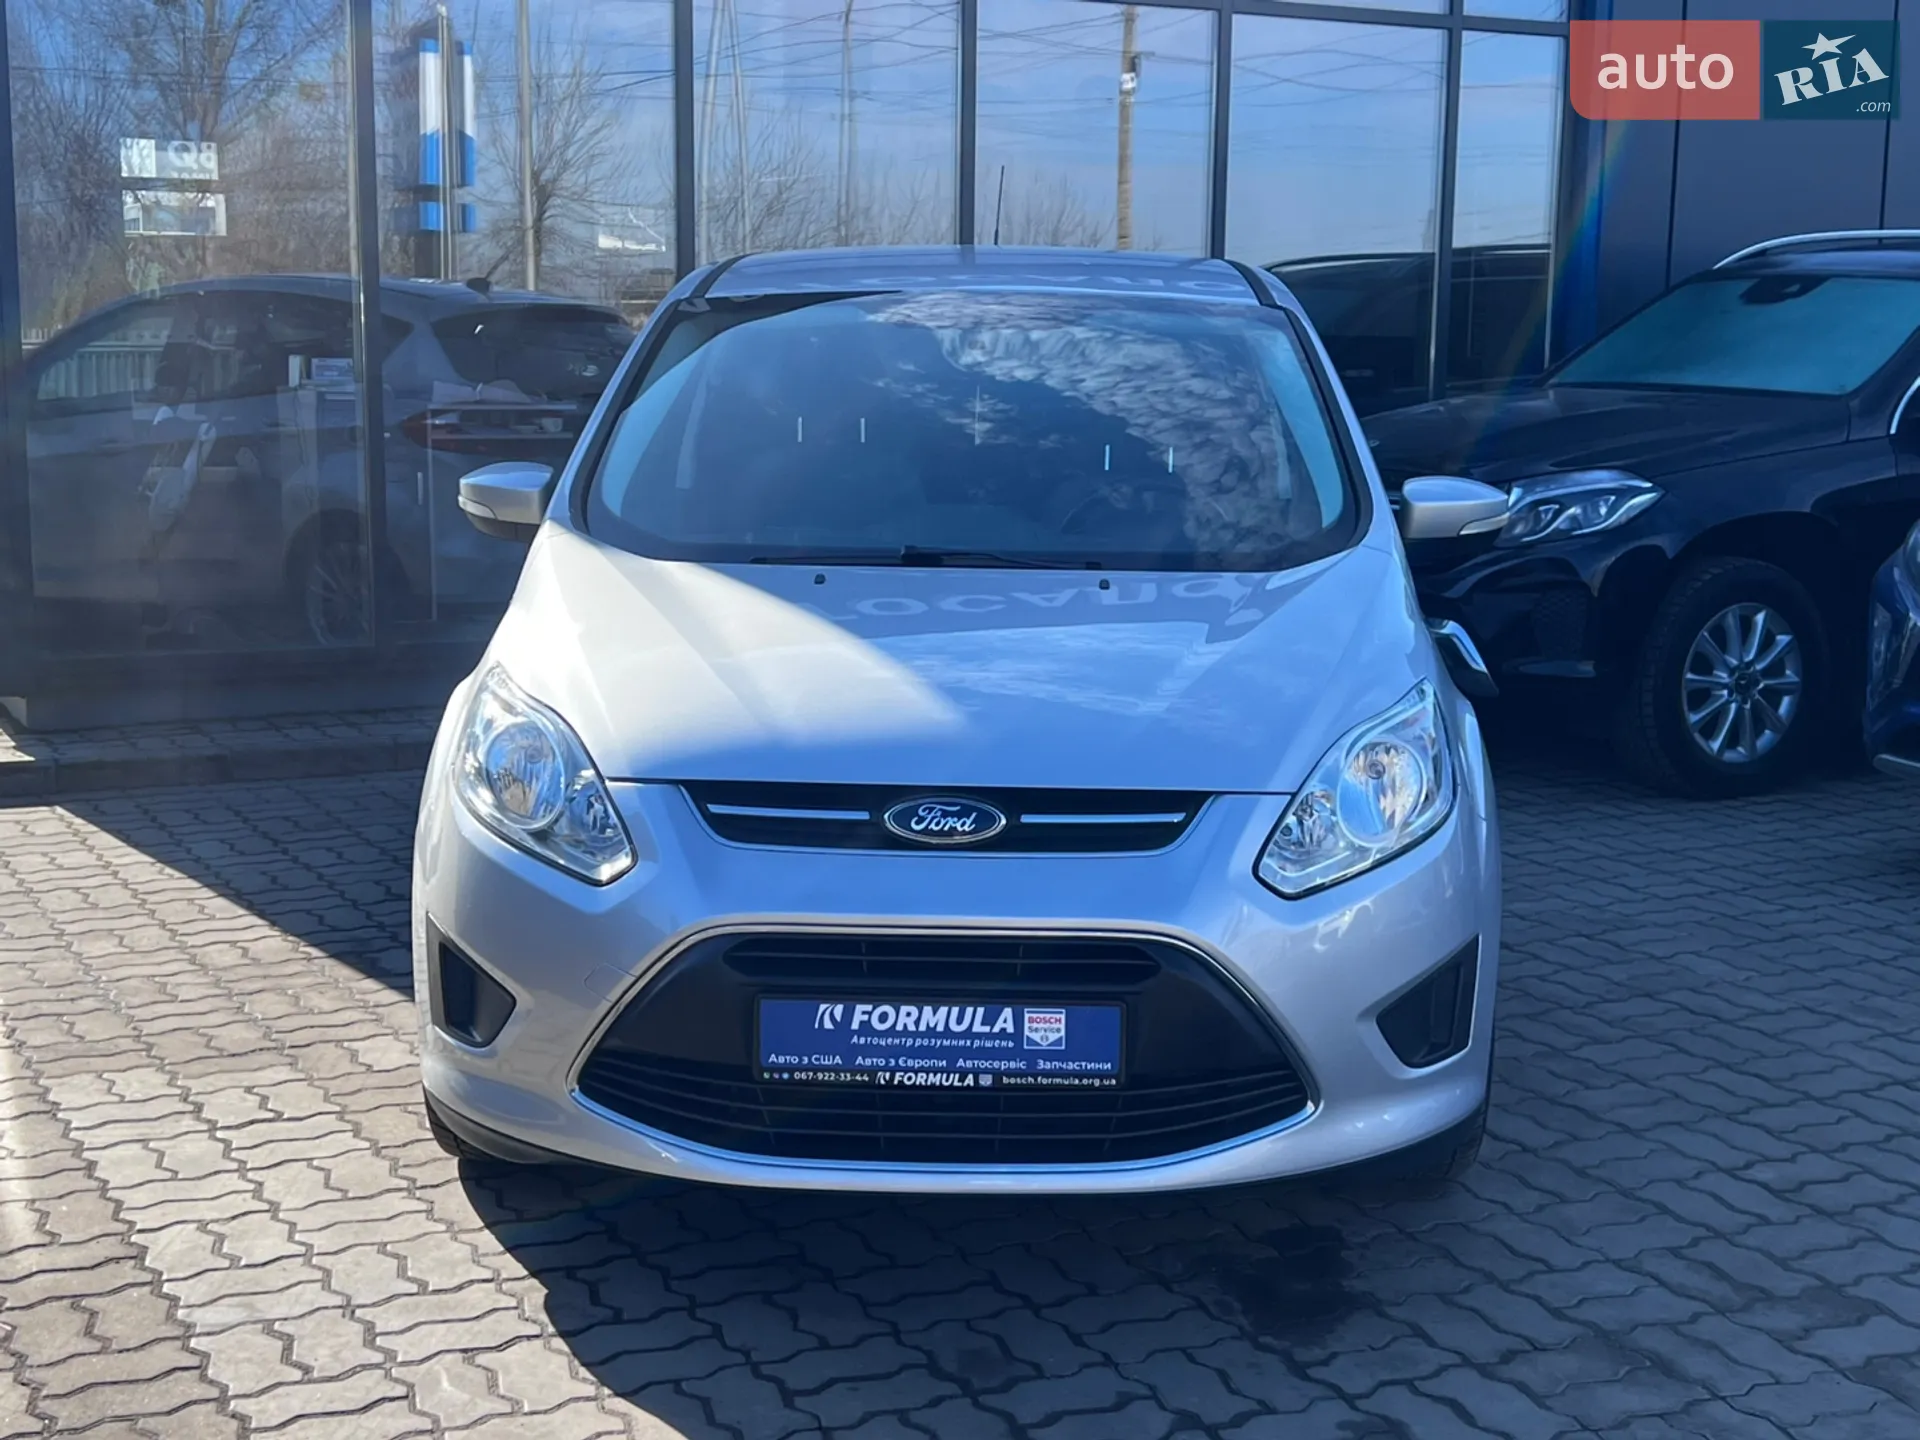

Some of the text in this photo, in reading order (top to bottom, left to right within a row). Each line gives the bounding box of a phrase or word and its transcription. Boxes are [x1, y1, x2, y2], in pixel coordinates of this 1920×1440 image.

[910, 803, 978, 832] Ford
[851, 1004, 1014, 1033] FORMULA
[1028, 1015, 1062, 1025] BOSCH
[1028, 1025, 1062, 1034] Service
[850, 1034, 1015, 1049] Автоцентр розумних рішень
[768, 1053, 799, 1065] Авто
[811, 1054, 843, 1066] США
[855, 1055, 886, 1067] Авто
[898, 1056, 947, 1069] Європи
[955, 1057, 1028, 1070] Автосервіс
[1036, 1059, 1112, 1071] Запчастини
[793, 1070, 870, 1082] 067-922-33-44
[893, 1071, 974, 1087] FORMULA
[1002, 1075, 1117, 1088] bosch.formula.org.ua
